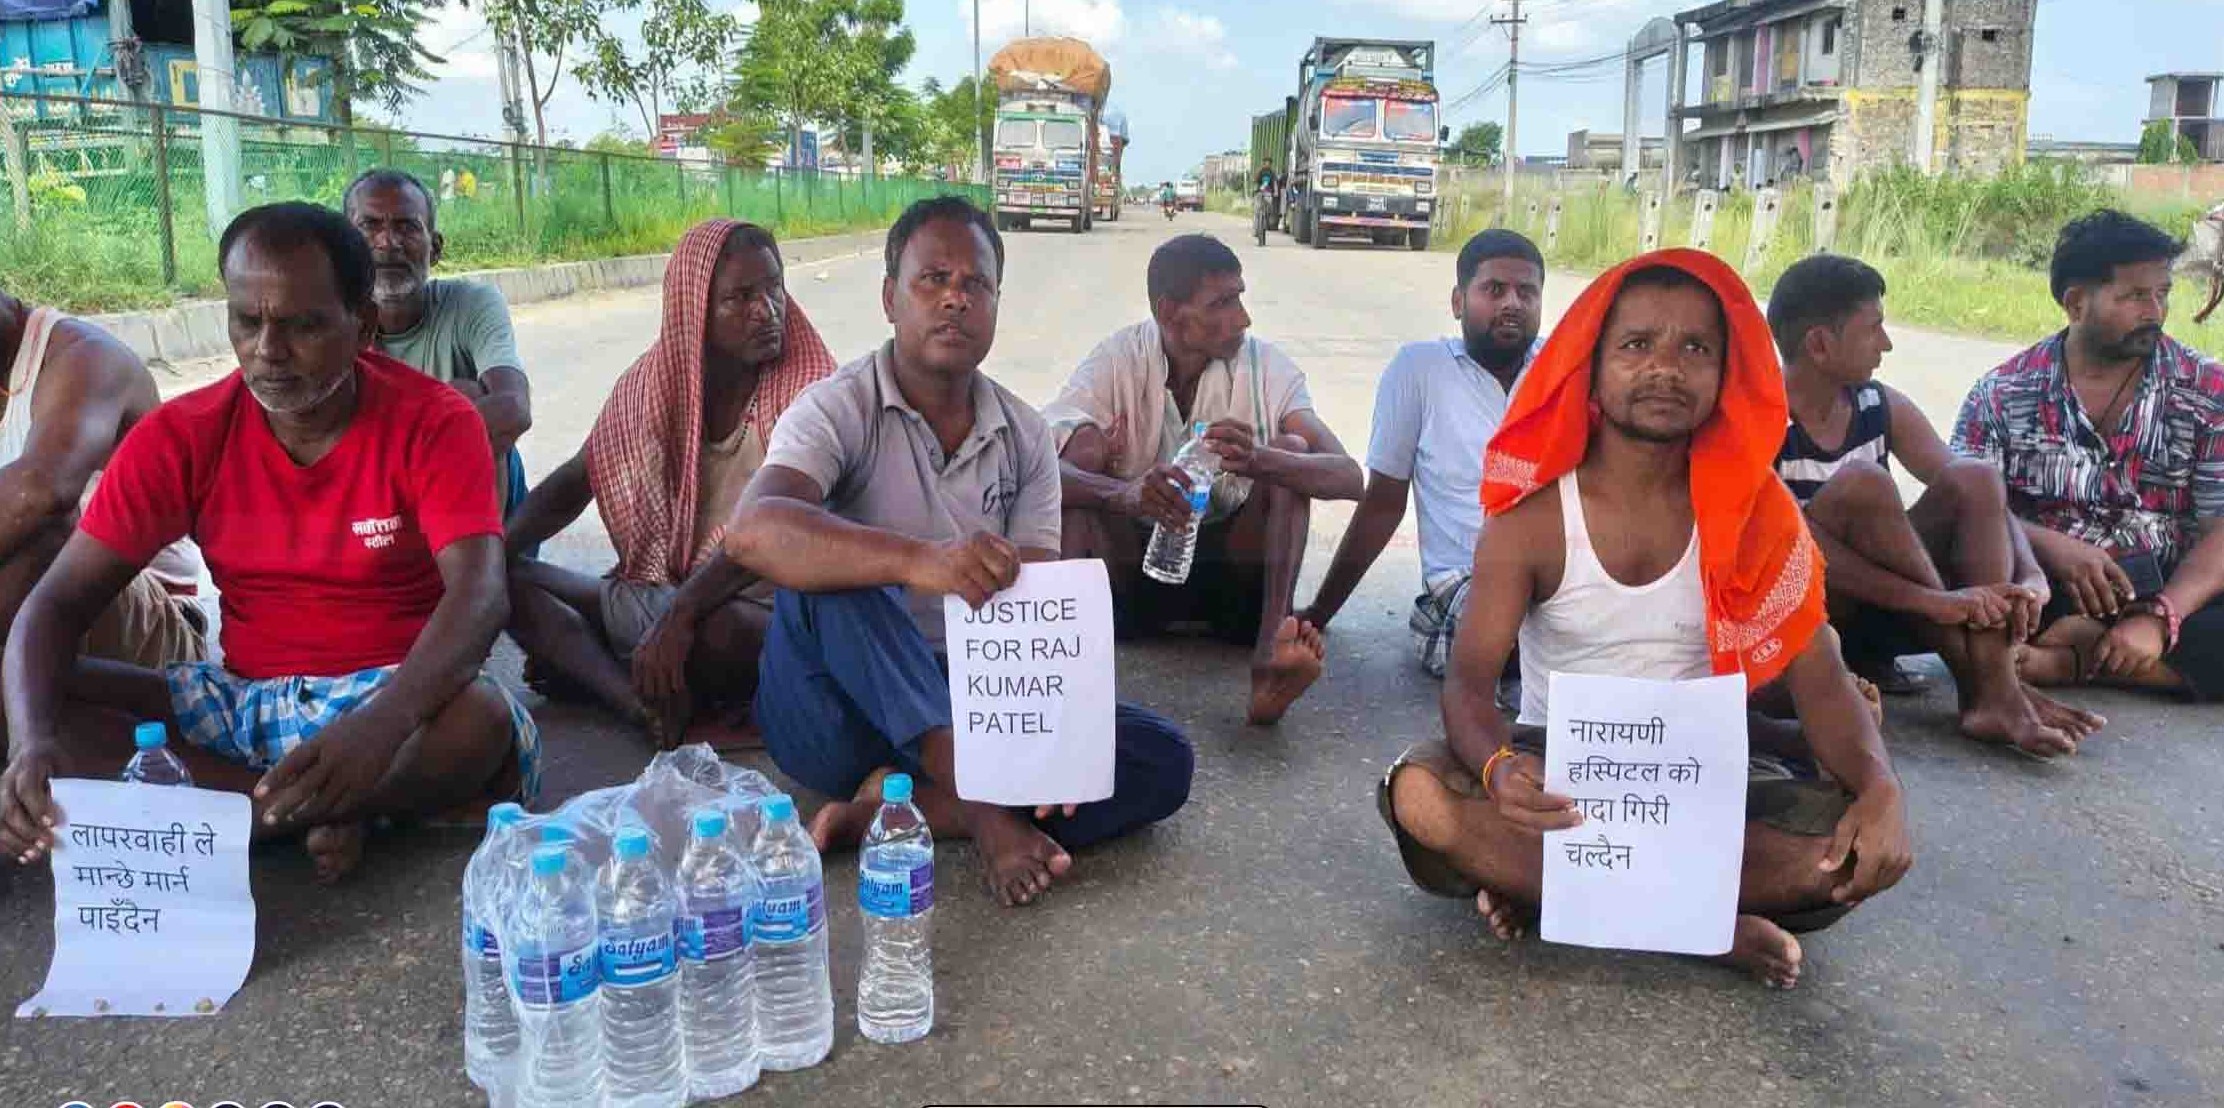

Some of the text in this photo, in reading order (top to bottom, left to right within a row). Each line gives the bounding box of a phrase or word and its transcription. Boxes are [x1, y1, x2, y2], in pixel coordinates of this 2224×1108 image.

[964, 598, 1077, 624] JUSTICE
[966, 636, 1080, 661] FOR RAJ
[968, 675, 1064, 697] KUMAR
[968, 711, 1053, 734] PATEL
[1569, 717, 1666, 745] नारायणी
[1567, 755, 1702, 784] हस्पिटल को
[1572, 793, 1670, 825] ादा गिरी
[70, 822, 217, 856] लापरवाही ले
[1563, 834, 1634, 869] चल्दैन
[73, 861, 189, 892] मान्छे मार्न
